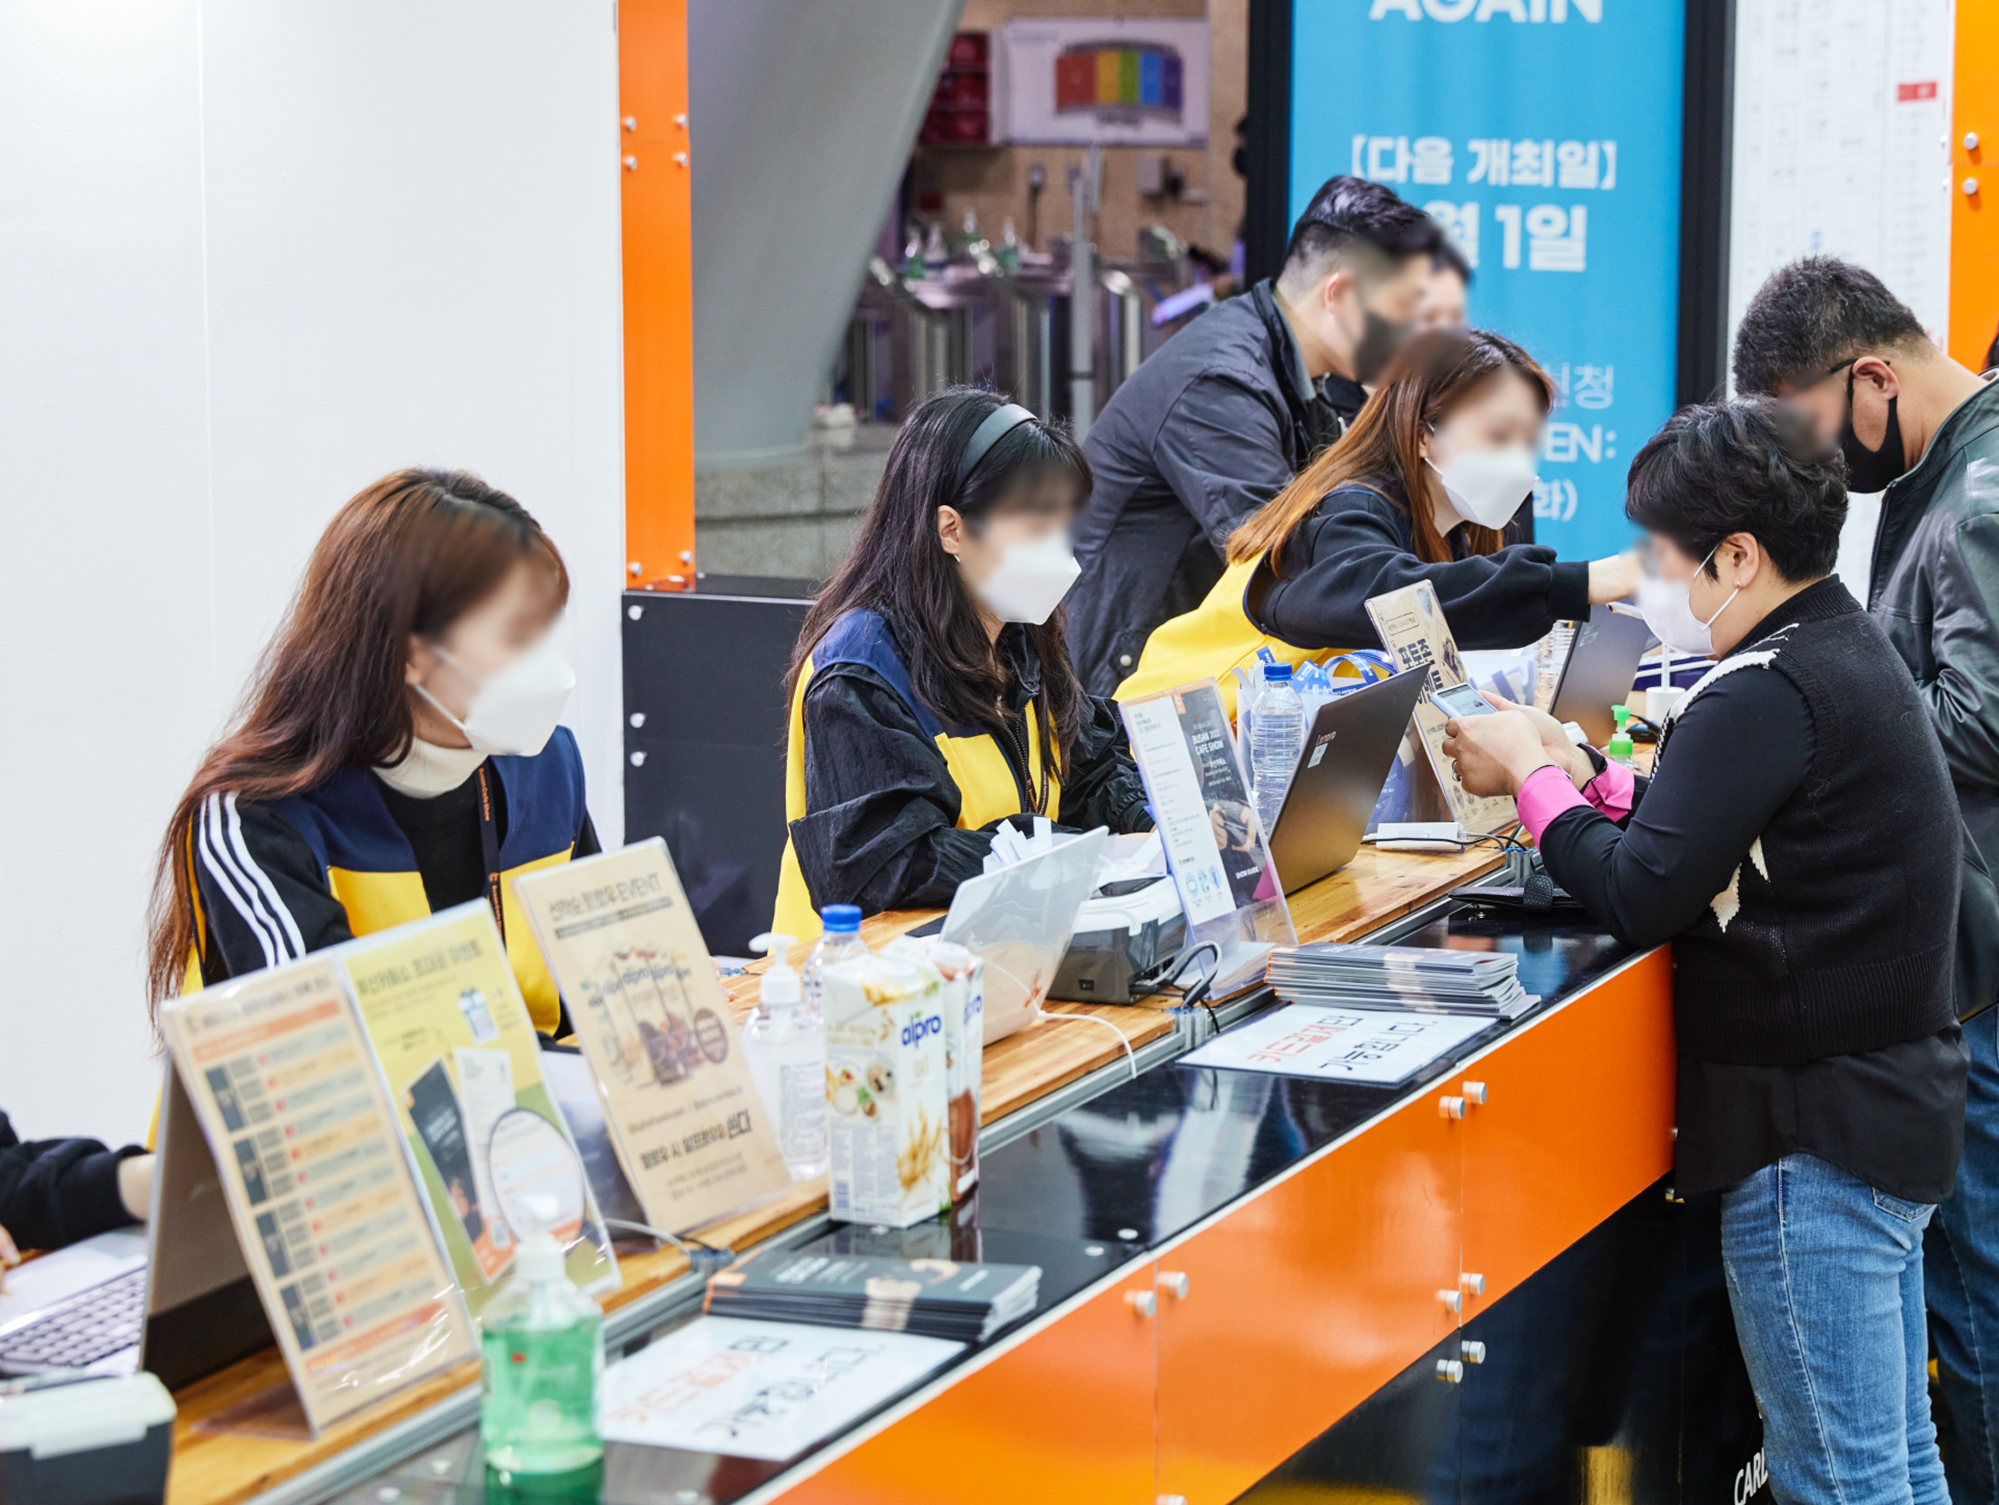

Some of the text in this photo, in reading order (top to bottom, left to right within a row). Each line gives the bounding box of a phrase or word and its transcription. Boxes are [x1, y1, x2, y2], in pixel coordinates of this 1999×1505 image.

[1495, 203, 1588, 273] 1일
[1195, 740, 1225, 755] CAFE SHOW
[1315, 731, 1337, 746] Lenovo
[615, 872, 662, 902] EVENT
[902, 1013, 942, 1049] alpro
